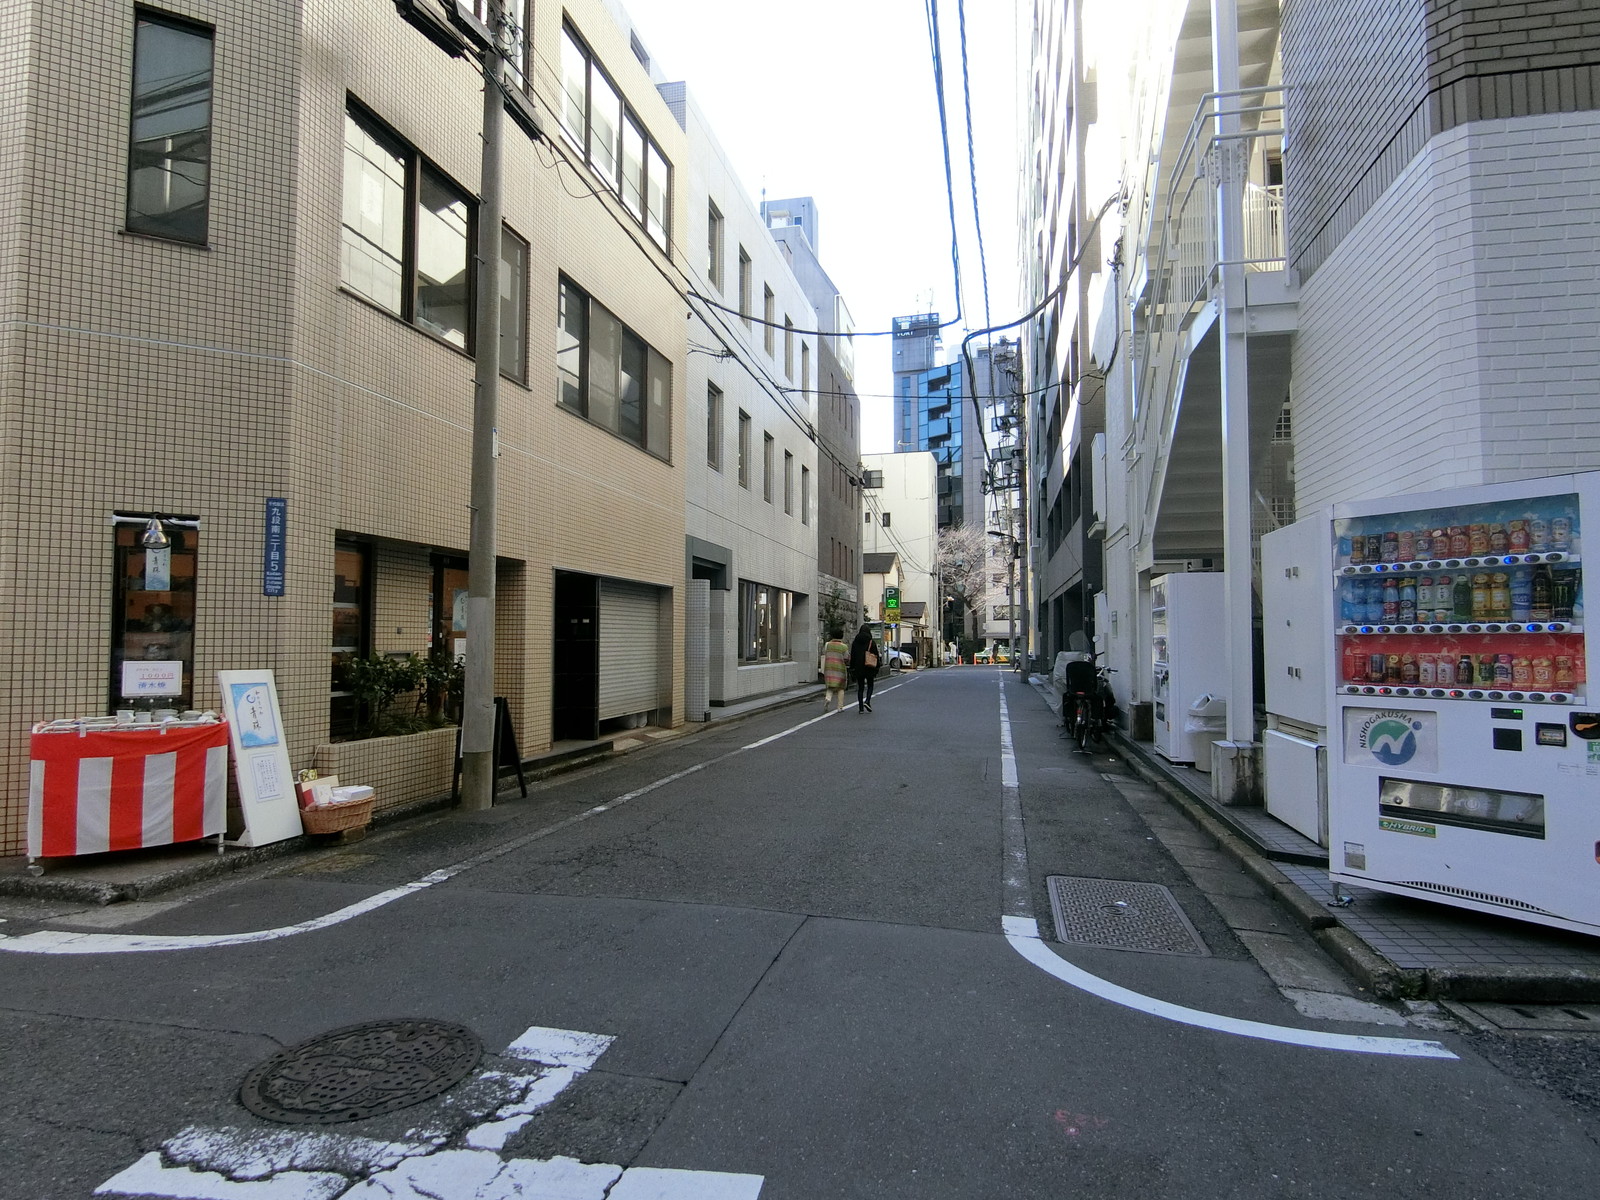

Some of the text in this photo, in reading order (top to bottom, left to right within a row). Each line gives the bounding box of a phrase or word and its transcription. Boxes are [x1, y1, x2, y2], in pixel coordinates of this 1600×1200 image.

[270, 508, 281, 571] 九段南二丁目5
[886, 589, 895, 598] P
[1360, 711, 1412, 749] NISHOGAKUSHA
[1388, 822, 1426, 833] HYBRID
